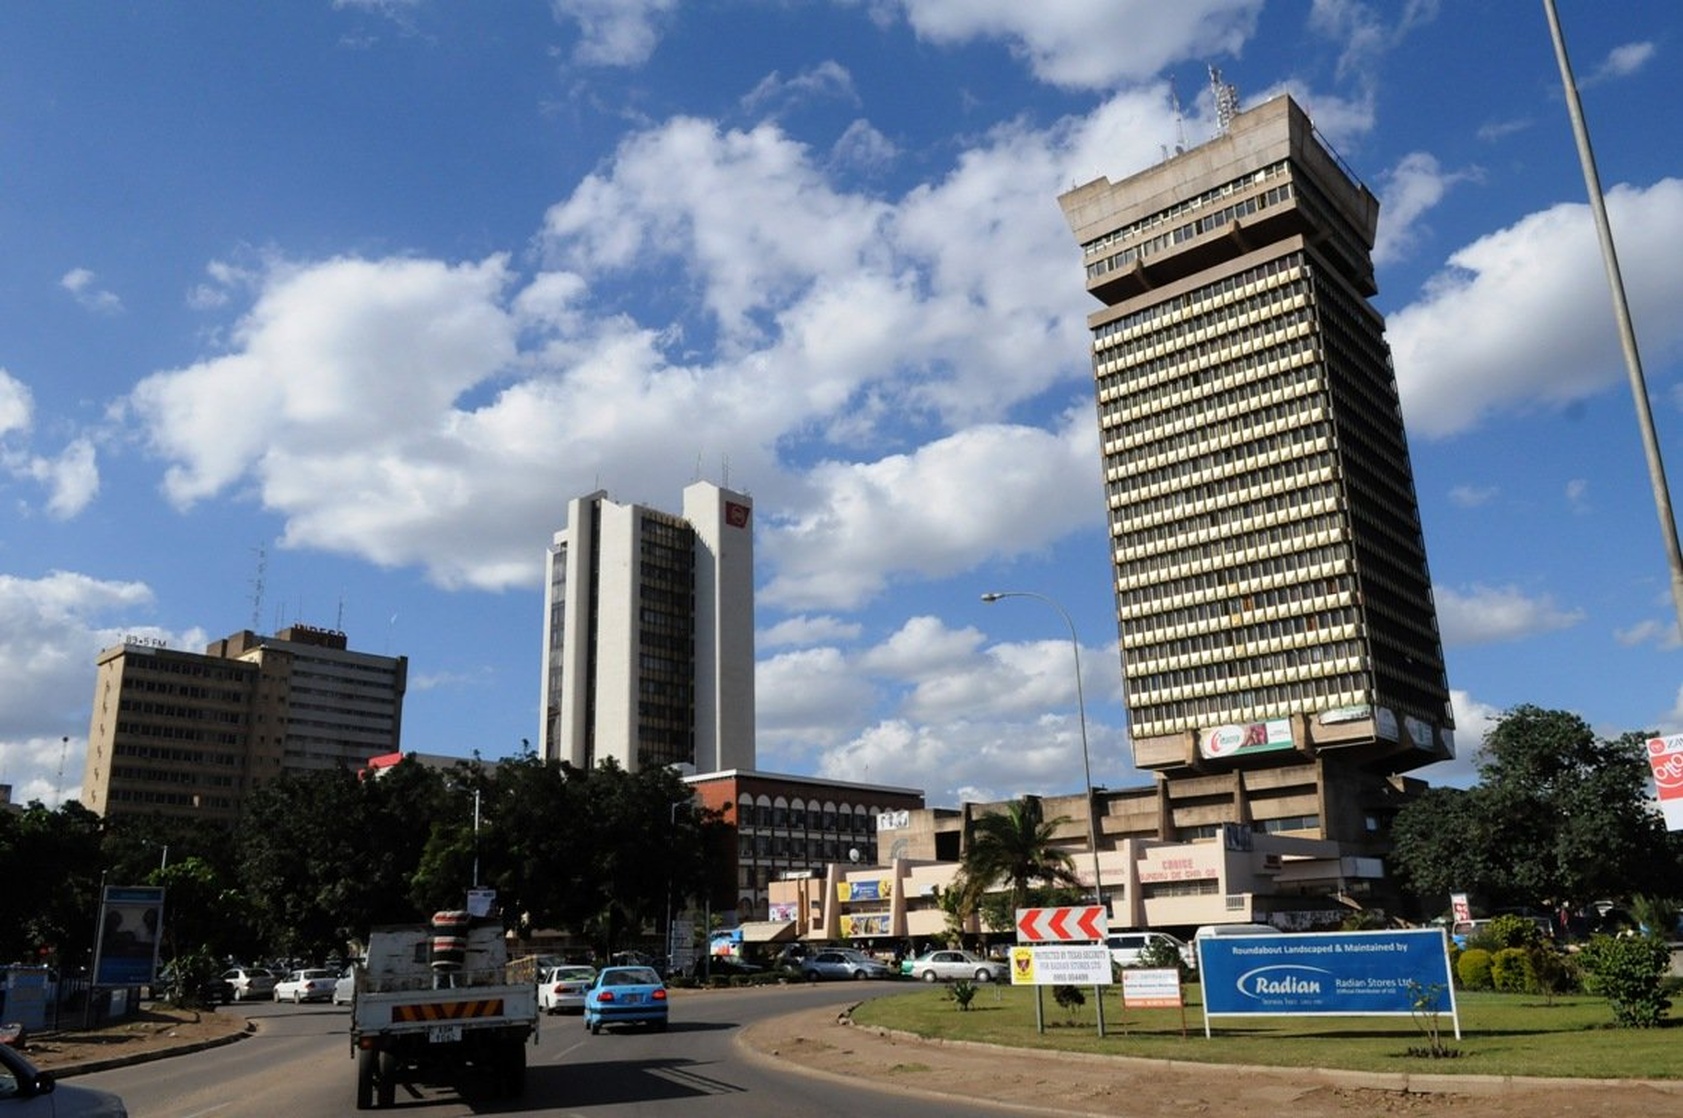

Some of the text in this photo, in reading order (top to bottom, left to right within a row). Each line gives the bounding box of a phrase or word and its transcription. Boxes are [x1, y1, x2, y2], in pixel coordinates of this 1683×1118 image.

[152, 638, 167, 647] FM
[1232, 943, 1408, 955] Roundabout Landscaped & Maintained by
[1061, 951, 1067, 959] BY
[1083, 950, 1106, 959] SECURITY
[1256, 975, 1320, 994] Radian
[1335, 978, 1367, 987] Radian
[1367, 977, 1397, 987] Stores
